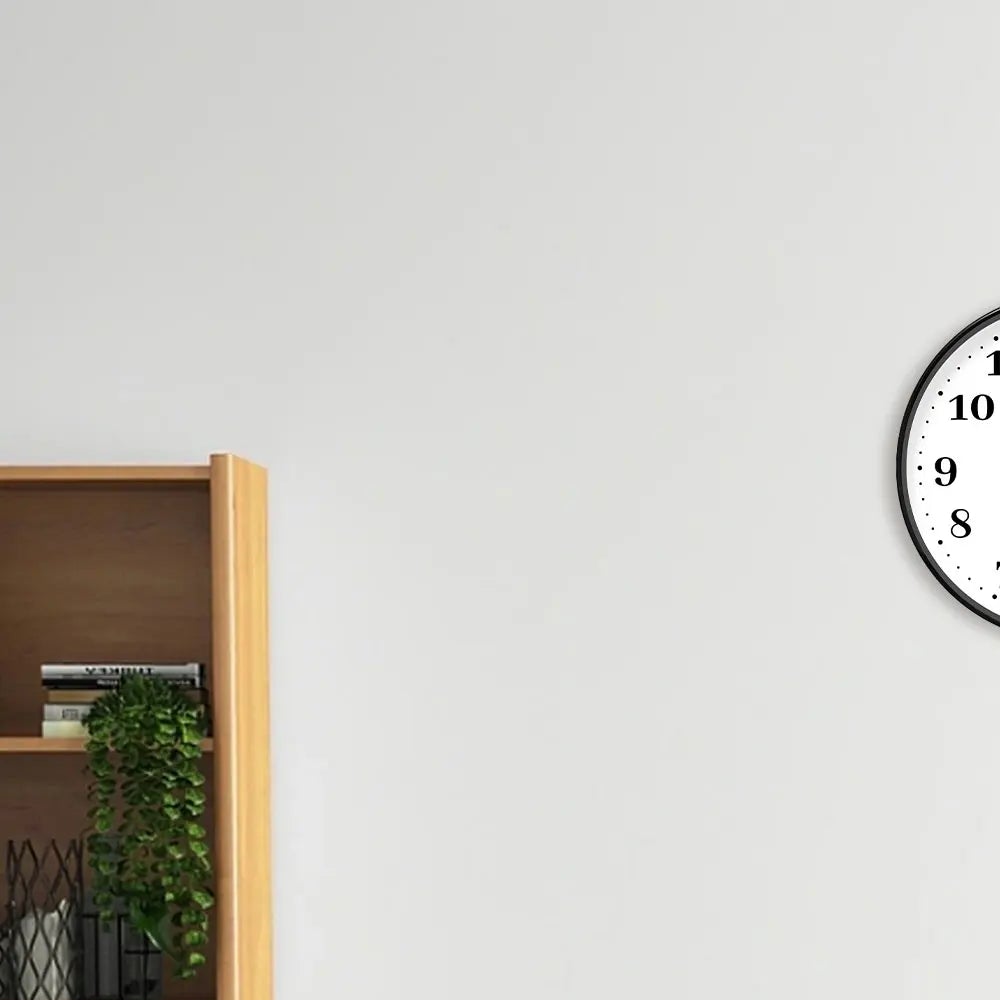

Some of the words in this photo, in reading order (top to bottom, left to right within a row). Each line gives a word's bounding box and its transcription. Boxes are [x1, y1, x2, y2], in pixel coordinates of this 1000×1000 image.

[949, 393, 995, 421] 10
[934, 456, 957, 487] 9
[950, 508, 972, 539] 8
